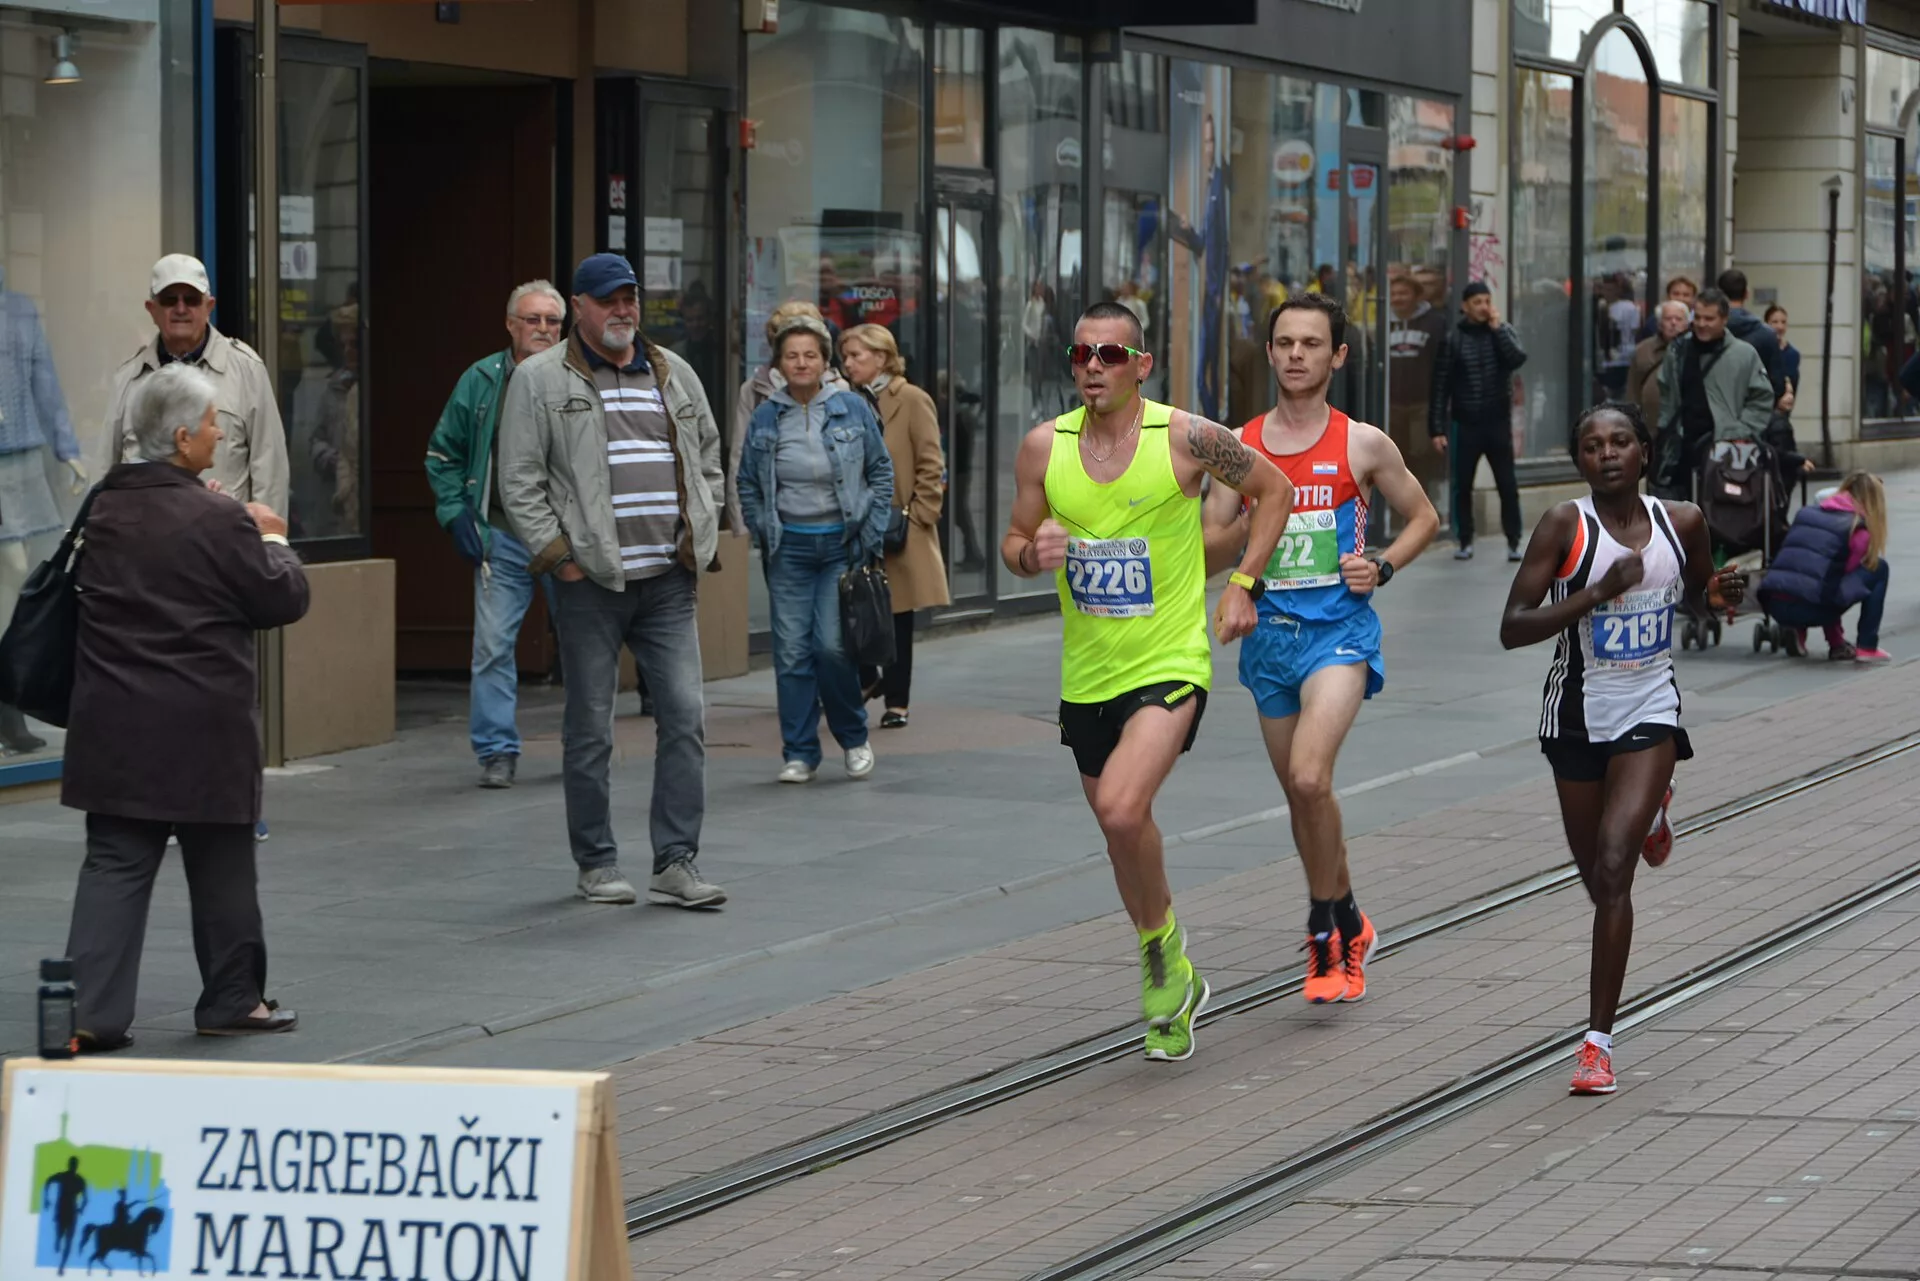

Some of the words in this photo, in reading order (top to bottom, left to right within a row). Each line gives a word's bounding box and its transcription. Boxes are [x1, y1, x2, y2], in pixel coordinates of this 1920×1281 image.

[852, 286, 896, 300] TOSCA
[1079, 548, 1127, 557] MARATON
[1277, 534, 1315, 568] 22
[1068, 560, 1147, 595] 2226
[1614, 600, 1662, 612] MARATON
[1603, 609, 1669, 652] 2131
[196, 1115, 542, 1202] ZAGREBAČKI
[191, 1212, 539, 1281] MARATON
